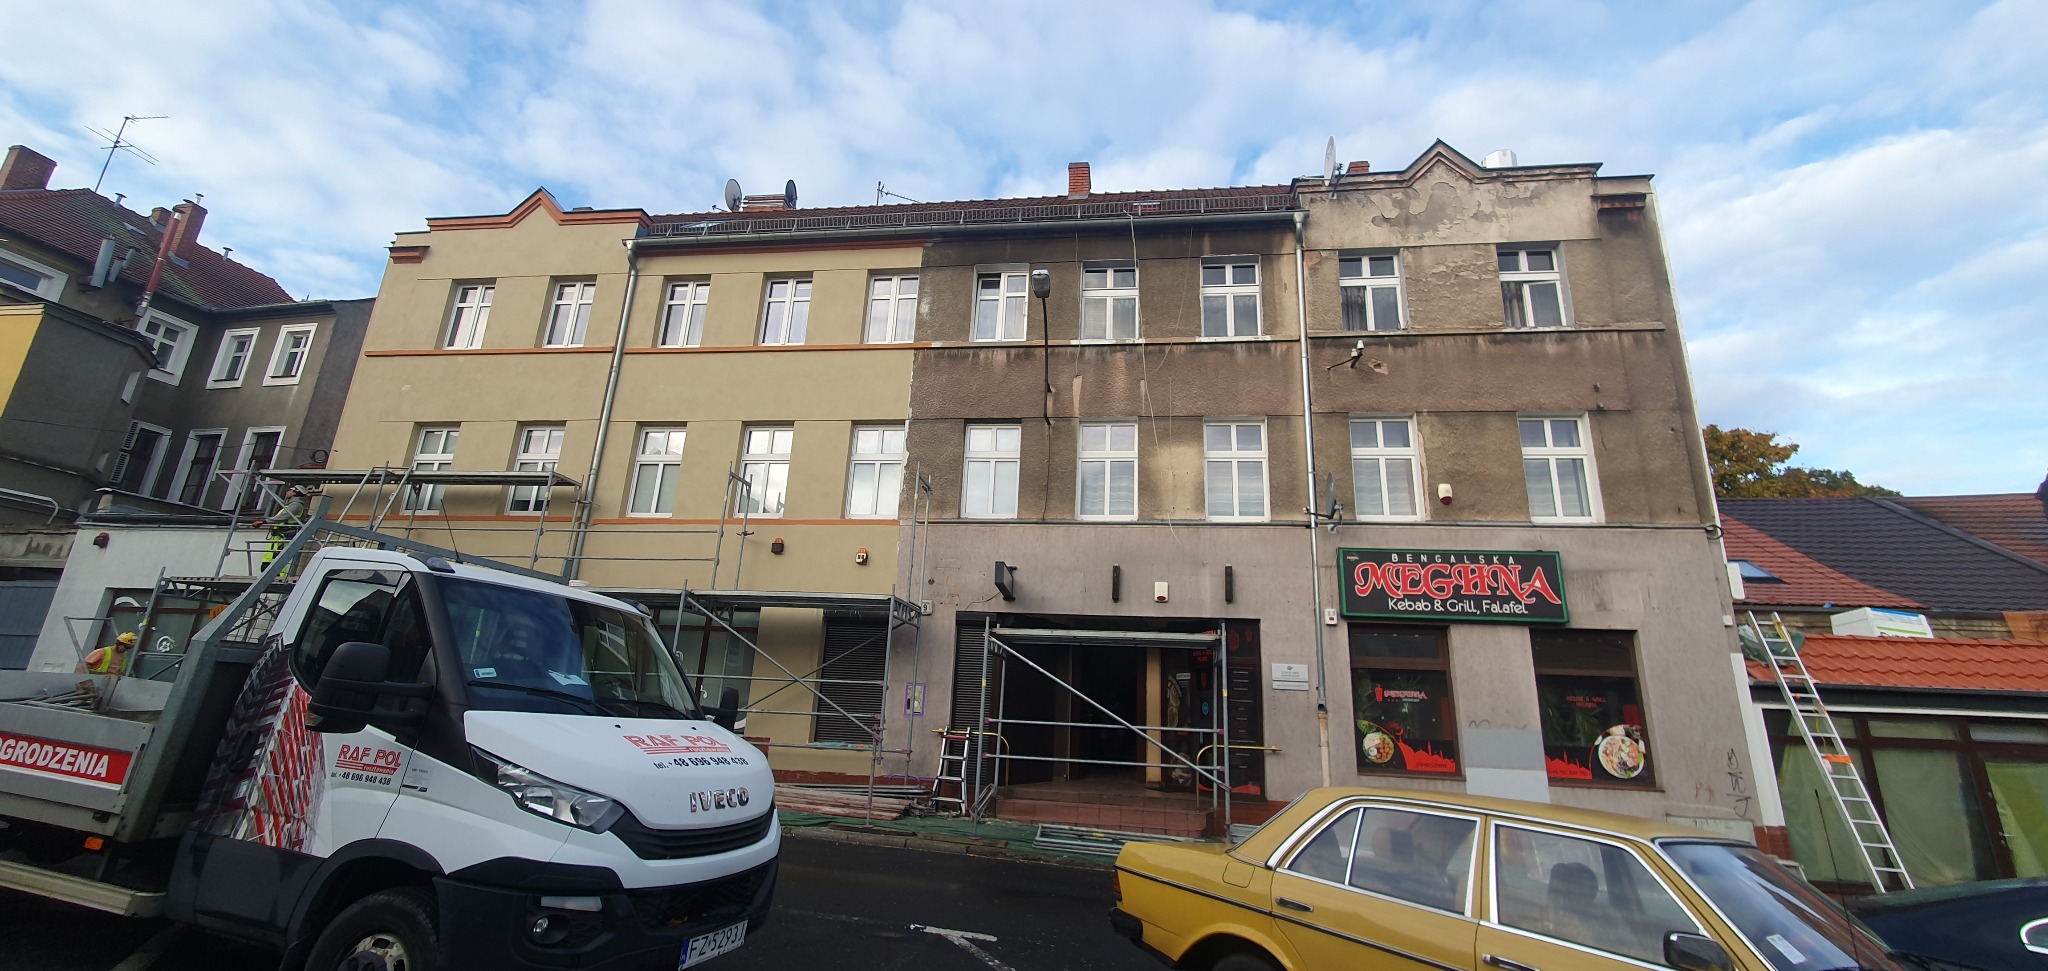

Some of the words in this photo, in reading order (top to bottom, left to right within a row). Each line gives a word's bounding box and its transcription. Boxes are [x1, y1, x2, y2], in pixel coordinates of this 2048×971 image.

[1391, 553, 1515, 565] BENGALSKA
[1354, 562, 1562, 604] MEGHNA
[1388, 598, 1431, 612] Kebab
[1434, 600, 1444, 612] &
[1446, 601, 1480, 615] Grill,
[1482, 600, 1529, 614] Falafel
[623, 735, 678, 747] RAF
[680, 735, 727, 747] POL
[0, 737, 109, 778] GRODZENIA
[338, 744, 371, 762] RAF
[374, 749, 401, 767] POL
[688, 757, 711, 766] 696
[710, 757, 731, 765] 948
[730, 757, 749, 765] 438
[351, 773, 363, 781] 696
[365, 775, 377, 783] 948
[378, 777, 391, 785] 438
[690, 787, 749, 812] IVECO
